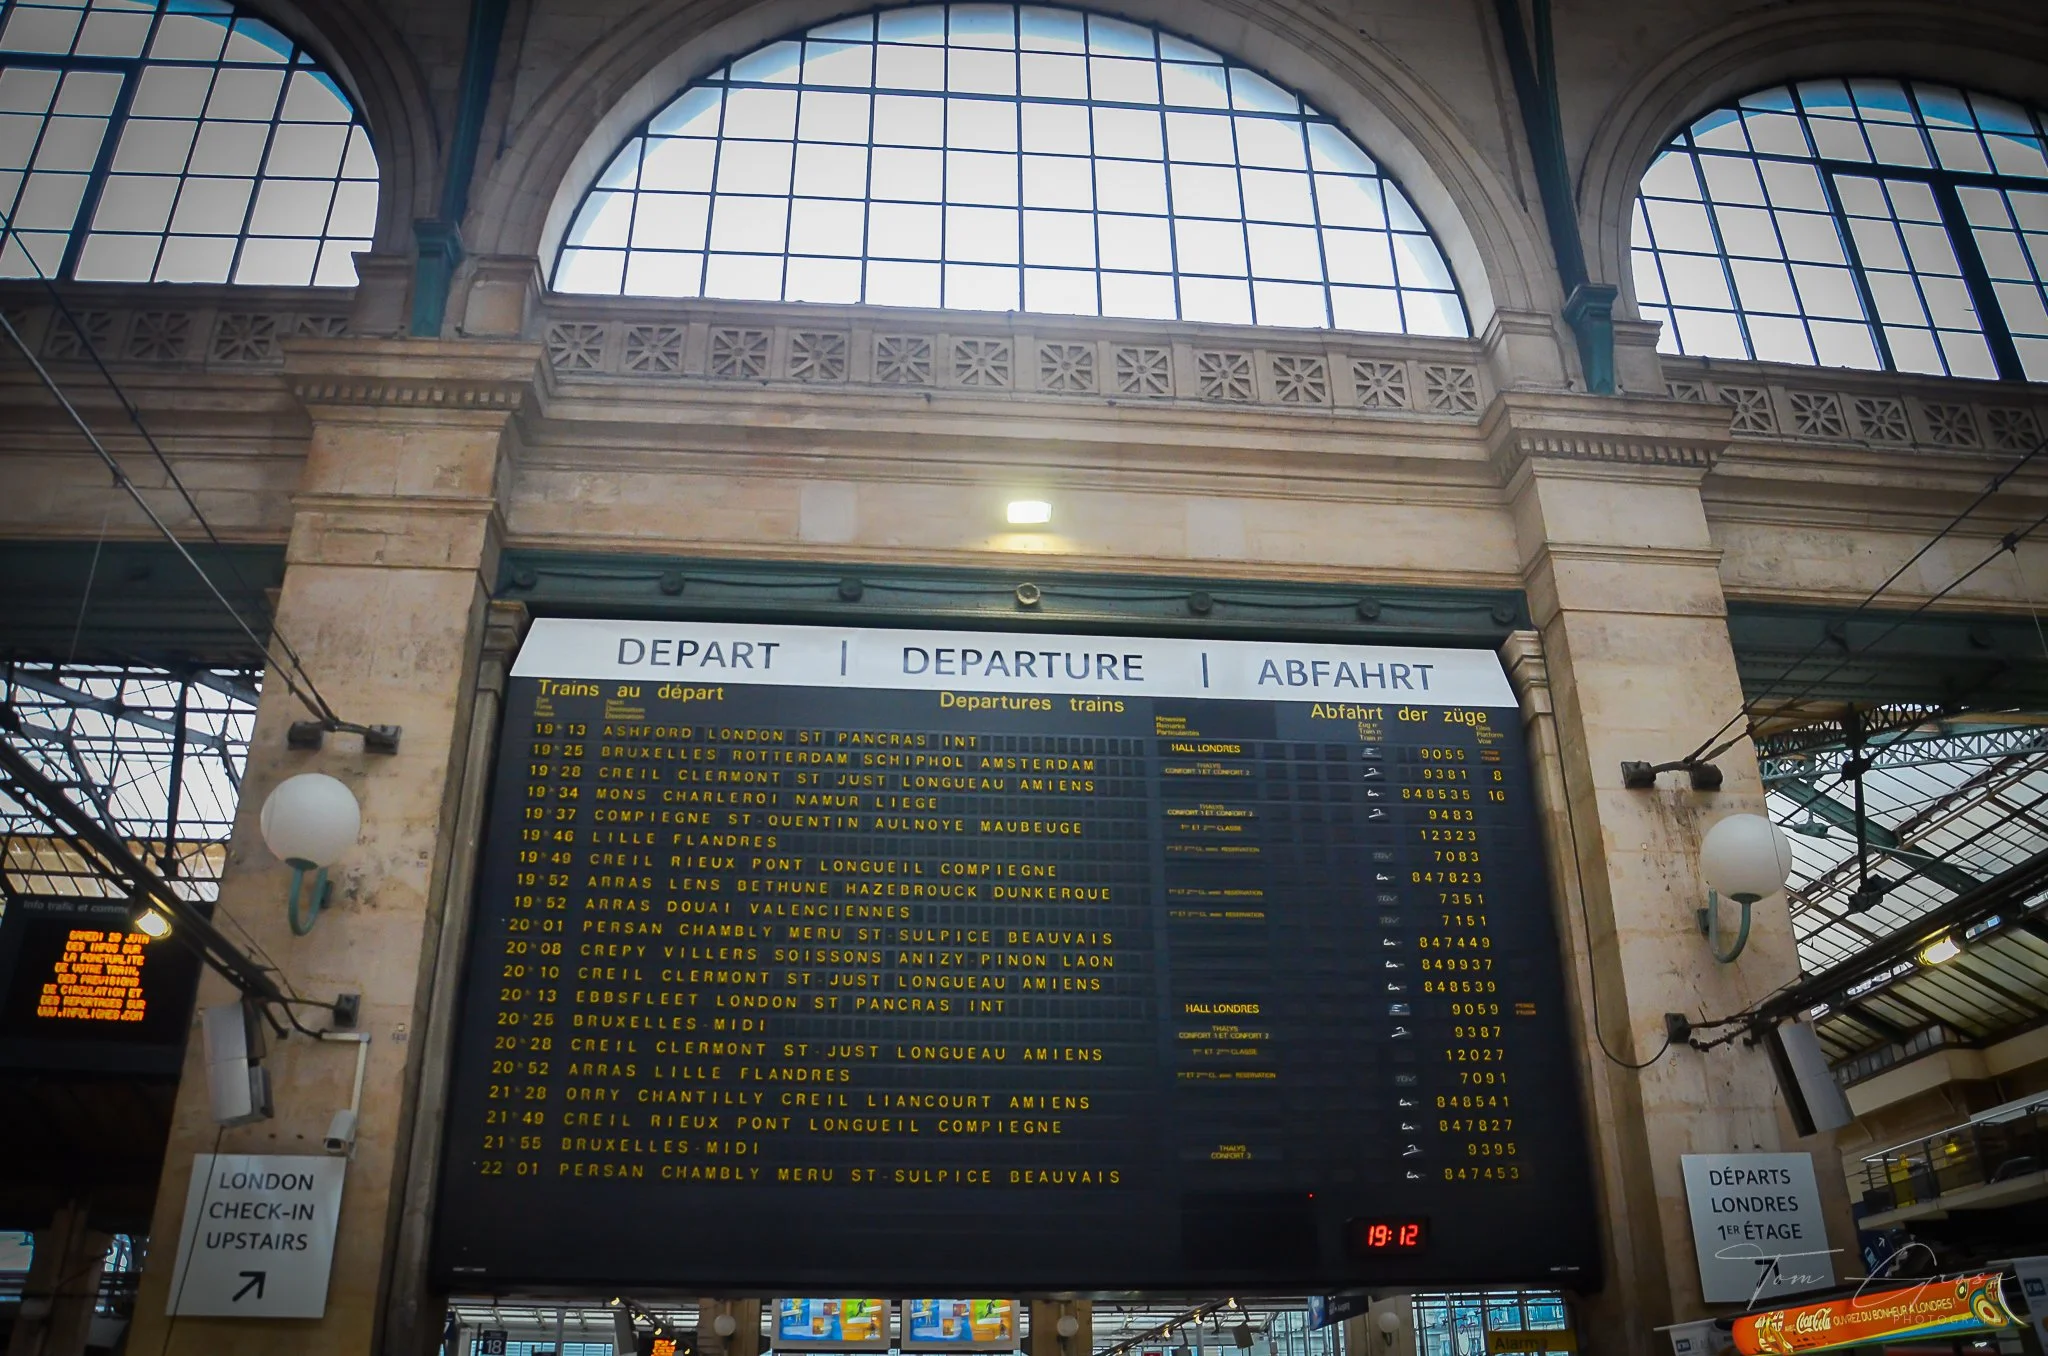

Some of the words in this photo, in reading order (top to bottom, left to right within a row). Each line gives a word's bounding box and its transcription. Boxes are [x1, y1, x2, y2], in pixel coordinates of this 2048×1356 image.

[617, 637, 780, 670] DEPART
[902, 647, 1145, 682] DEPARTURE
[1257, 659, 1434, 691] ABFAHRT
[538, 679, 600, 698] Trains
[617, 684, 641, 698] au
[657, 682, 724, 703] départ
[940, 691, 1052, 713] Departures
[1070, 696, 1125, 714] trains
[1311, 703, 1384, 721] Abfahrt
[1398, 706, 1428, 722] der
[1443, 708, 1487, 726] züge
[604, 725, 693, 739] ASHFORD
[708, 728, 784, 742] LONDON
[799, 731, 821, 744] ST
[838, 732, 925, 746] PANCRAS
[944, 735, 976, 748] INT
[1171, 743, 1195, 753] HALL
[1198, 743, 1241, 754] LONDRES
[1420, 748, 1464, 761] 9055
[601, 745, 717, 761] BRUXELLES
[732, 749, 849, 765] ROTTERDAM
[863, 753, 963, 769] SCHIPHOL
[980, 756, 1095, 772] AMSTERDAM
[599, 766, 659, 781] CREIL
[677, 768, 780, 783] CLERMONT
[797, 772, 818, 785] ST
[837, 774, 885, 786] JUST
[902, 775, 1005, 791] LONGUEAU
[1019, 778, 1094, 793] AMIENS
[1423, 768, 1467, 781] 9381
[1492, 769, 1503, 782] 8
[595, 787, 646, 801] MONS
[662, 789, 778, 806] CHARLEROI
[794, 793, 860, 808] NAMUR
[875, 796, 937, 810] LIEGE
[1402, 787, 1471, 801] 848535
[1488, 789, 1505, 801] 16
[594, 808, 710, 825] COMPIEGNE
[875, 817, 963, 832] AULNOYE
[980, 819, 1081, 836] MAUBEUGE
[1428, 808, 1474, 822] 9483
[592, 831, 655, 845] LILLE
[672, 832, 777, 849] FLANDRES
[1420, 829, 1477, 842] 12323
[590, 853, 652, 868] CREIL
[670, 854, 735, 870] RIEUX
[751, 856, 803, 872] PONT
[819, 859, 922, 876] LONGUEIL
[940, 863, 1056, 878] COMPIEGNE
[1434, 850, 1480, 864] 7083
[1411, 871, 1483, 885] 847823
[587, 874, 653, 890] ARRAS
[668, 877, 721, 892] LENS
[736, 879, 828, 896] BETHUNE
[845, 882, 977, 897] HAZEBROUCK
[992, 885, 1110, 901] DUNKERQUE
[1440, 892, 1484, 905] 7351
[584, 897, 651, 913] ARRAS
[666, 899, 730, 914] DOUAI
[749, 902, 910, 919] VALENCIENNES
[1443, 913, 1487, 928] 7151
[582, 919, 663, 936] PERSAN
[678, 922, 772, 939] CHAMBLY
[788, 926, 842, 941] MERU
[1007, 930, 1113, 946] BEAUVAIS
[1418, 936, 1491, 950] 847449
[580, 942, 645, 958] CREPY
[663, 946, 757, 962] VILLERS
[774, 948, 882, 965] SOISSONS
[1062, 954, 1115, 969] LAON
[1421, 958, 1493, 972] 849937
[578, 966, 642, 982] CREIL
[660, 968, 769, 985] CLERMONT
[898, 974, 1006, 990] LONGUEAU
[1023, 976, 1102, 992] AMIENS
[1423, 980, 1497, 994] 848539
[575, 989, 698, 1007] EBBSFLEET
[715, 993, 798, 1009] LONDON
[814, 995, 838, 1010] ST
[855, 997, 951, 1013] PANCRAS
[969, 999, 1004, 1013] INT
[1185, 1004, 1211, 1013] HALL
[1213, 1004, 1260, 1014] LONDRES
[1451, 1002, 1500, 1017] 9059
[1454, 1025, 1501, 1040] 9387
[570, 1037, 636, 1054] CREIL
[655, 1039, 767, 1057] CLERMONT
[896, 1045, 1007, 1062] LONGUEAU
[1023, 1047, 1103, 1062] AMIENS
[1445, 1048, 1504, 1063] 12027
[568, 1062, 637, 1078] ARRAS
[654, 1065, 720, 1080] LILLE
[739, 1066, 850, 1083] FLANDRES
[1461, 1071, 1507, 1085] 7091
[565, 1087, 618, 1102] ORRY
[637, 1088, 764, 1105] CHANTILLY
[780, 1091, 848, 1108] CREIL
[866, 1093, 991, 1109] LIANCOURT
[1009, 1095, 1090, 1111] AMIENS
[1435, 1094, 1509, 1109] 848541
[563, 1111, 629, 1127] CREIL
[649, 1113, 719, 1130] RIEUX
[736, 1115, 791, 1131] PONT
[809, 1117, 920, 1134] LONGUEIL
[937, 1118, 1061, 1135] COMPIEGNE
[1439, 1118, 1513, 1133] 847827
[1467, 1142, 1517, 1156] 9395
[219, 1171, 314, 1191] LONDON
[559, 1162, 644, 1179] PERSAN
[661, 1164, 758, 1181] CHAMBLY
[777, 1167, 834, 1182] MERU
[1009, 1169, 1120, 1185] BEAUVAIS
[1444, 1166, 1520, 1181] 847453
[1709, 1166, 1791, 1186] DÉPARTS
[208, 1202, 315, 1221] CHECK-IN
[1711, 1196, 1799, 1214] LONDRES
[1745, 1220, 1803, 1241] ÉTAGE
[206, 1232, 308, 1251] UPSTAIRS
[1872, 1304, 1908, 1321] BONHEUR
[486, 1340, 502, 1354] 18
